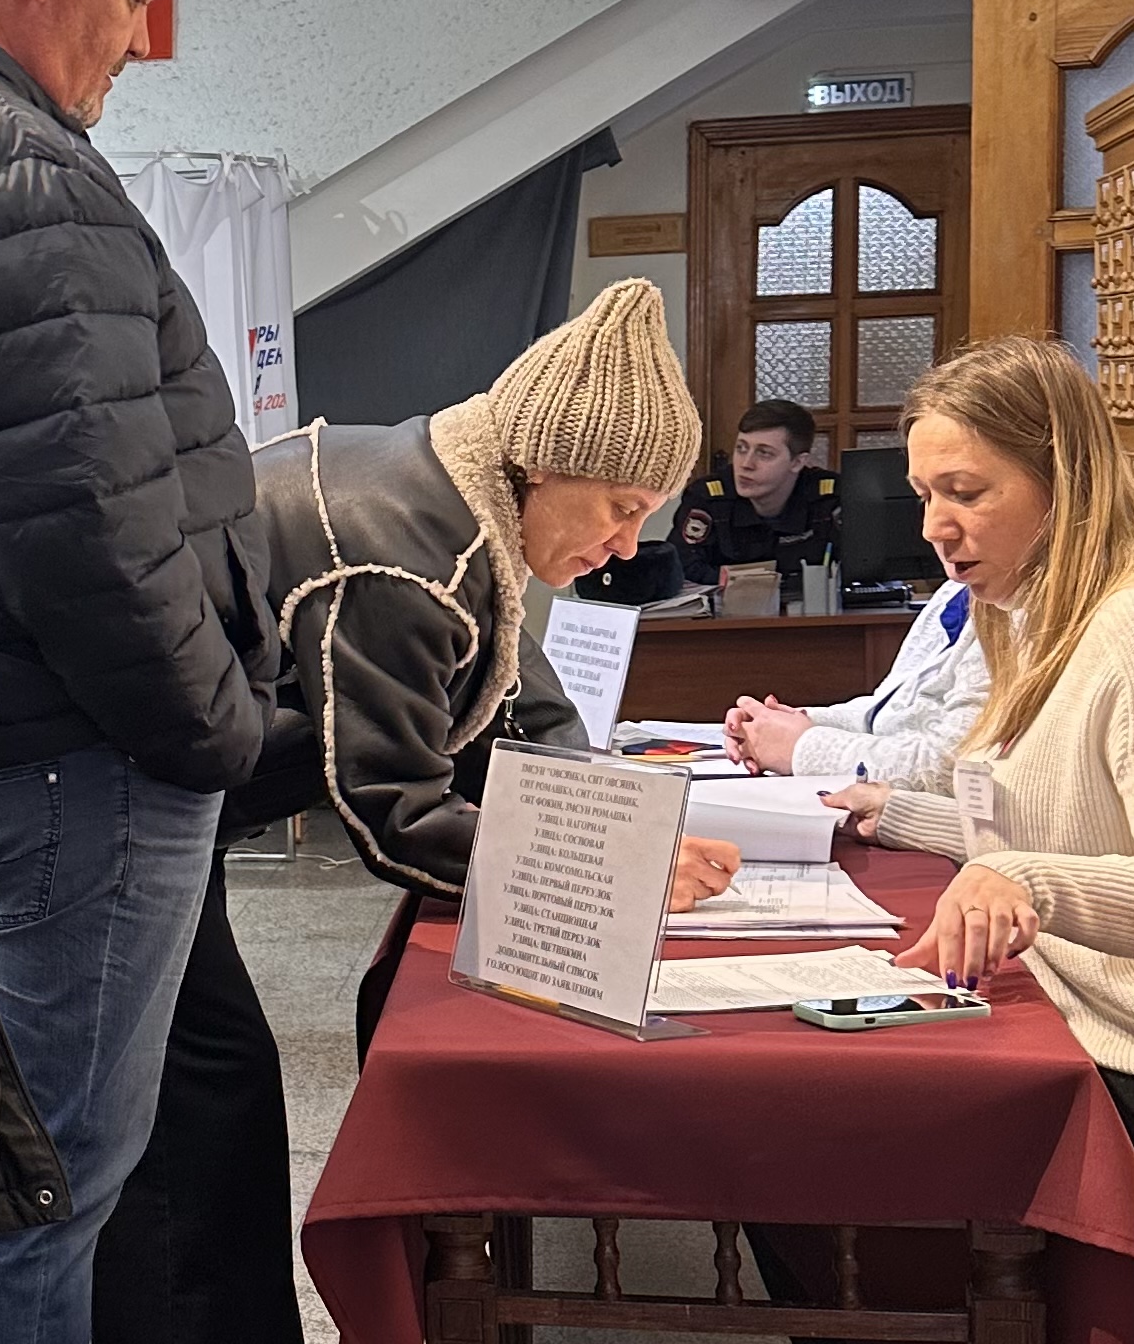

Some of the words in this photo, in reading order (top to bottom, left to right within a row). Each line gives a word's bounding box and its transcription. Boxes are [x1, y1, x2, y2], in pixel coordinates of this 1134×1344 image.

[814, 81, 901, 105] ВЫХОД
[255, 324, 280, 344] РЫ
[591, 806, 633, 823] РОМАШКА
[566, 818, 608, 835] НАГОРНАЯ
[563, 833, 606, 850] СОСНОВАЯ
[558, 848, 605, 867] КОЛЬЦЕВАЯ
[543, 861, 615, 885] КОМСОМОЛЬСКАЯ
[539, 875, 571, 891] ПЕРВЫЙ
[571, 883, 614, 901] ПЕРЕУЛОК
[573, 900, 616, 919] ПЕРЕУЛОК
[561, 929, 603, 949] ПЕРЕУЛОК
[539, 973, 551, 985] ПО
[566, 964, 600, 982] СПИСОК
